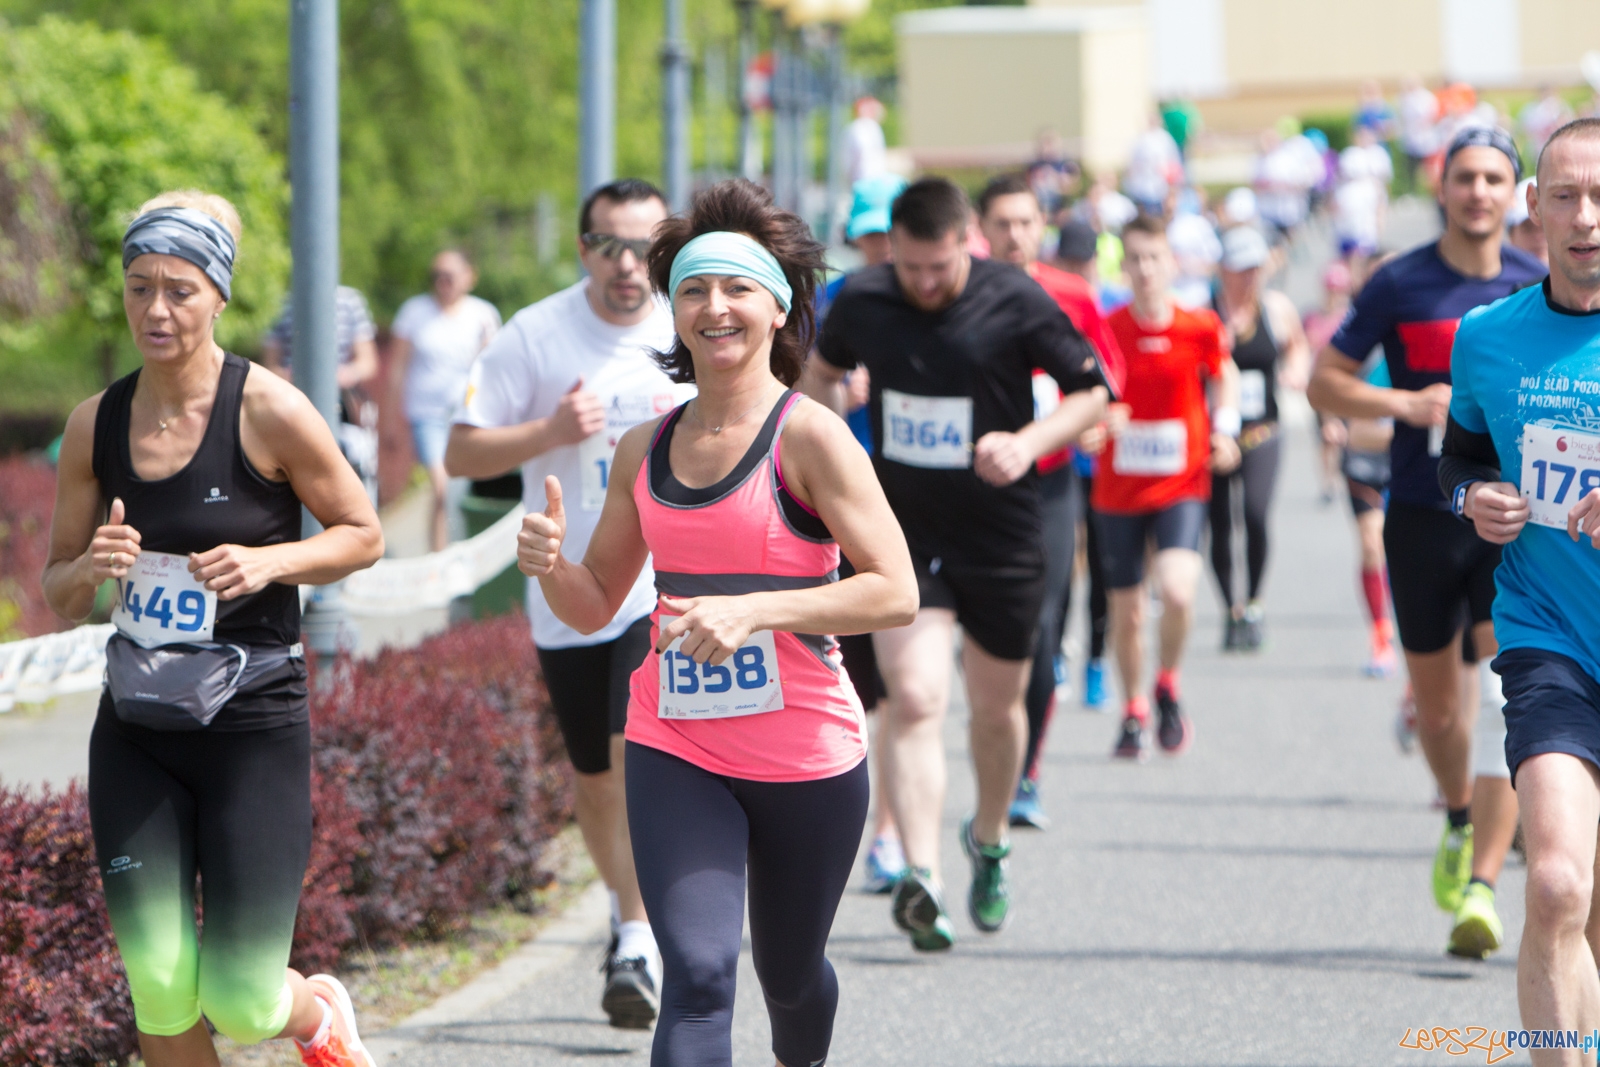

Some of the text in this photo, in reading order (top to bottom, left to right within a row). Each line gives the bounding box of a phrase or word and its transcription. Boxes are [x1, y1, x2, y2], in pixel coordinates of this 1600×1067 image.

[1517, 393, 1580, 409] W POZNANIU
[890, 413, 963, 449] 1364
[664, 645, 767, 695] 1358
